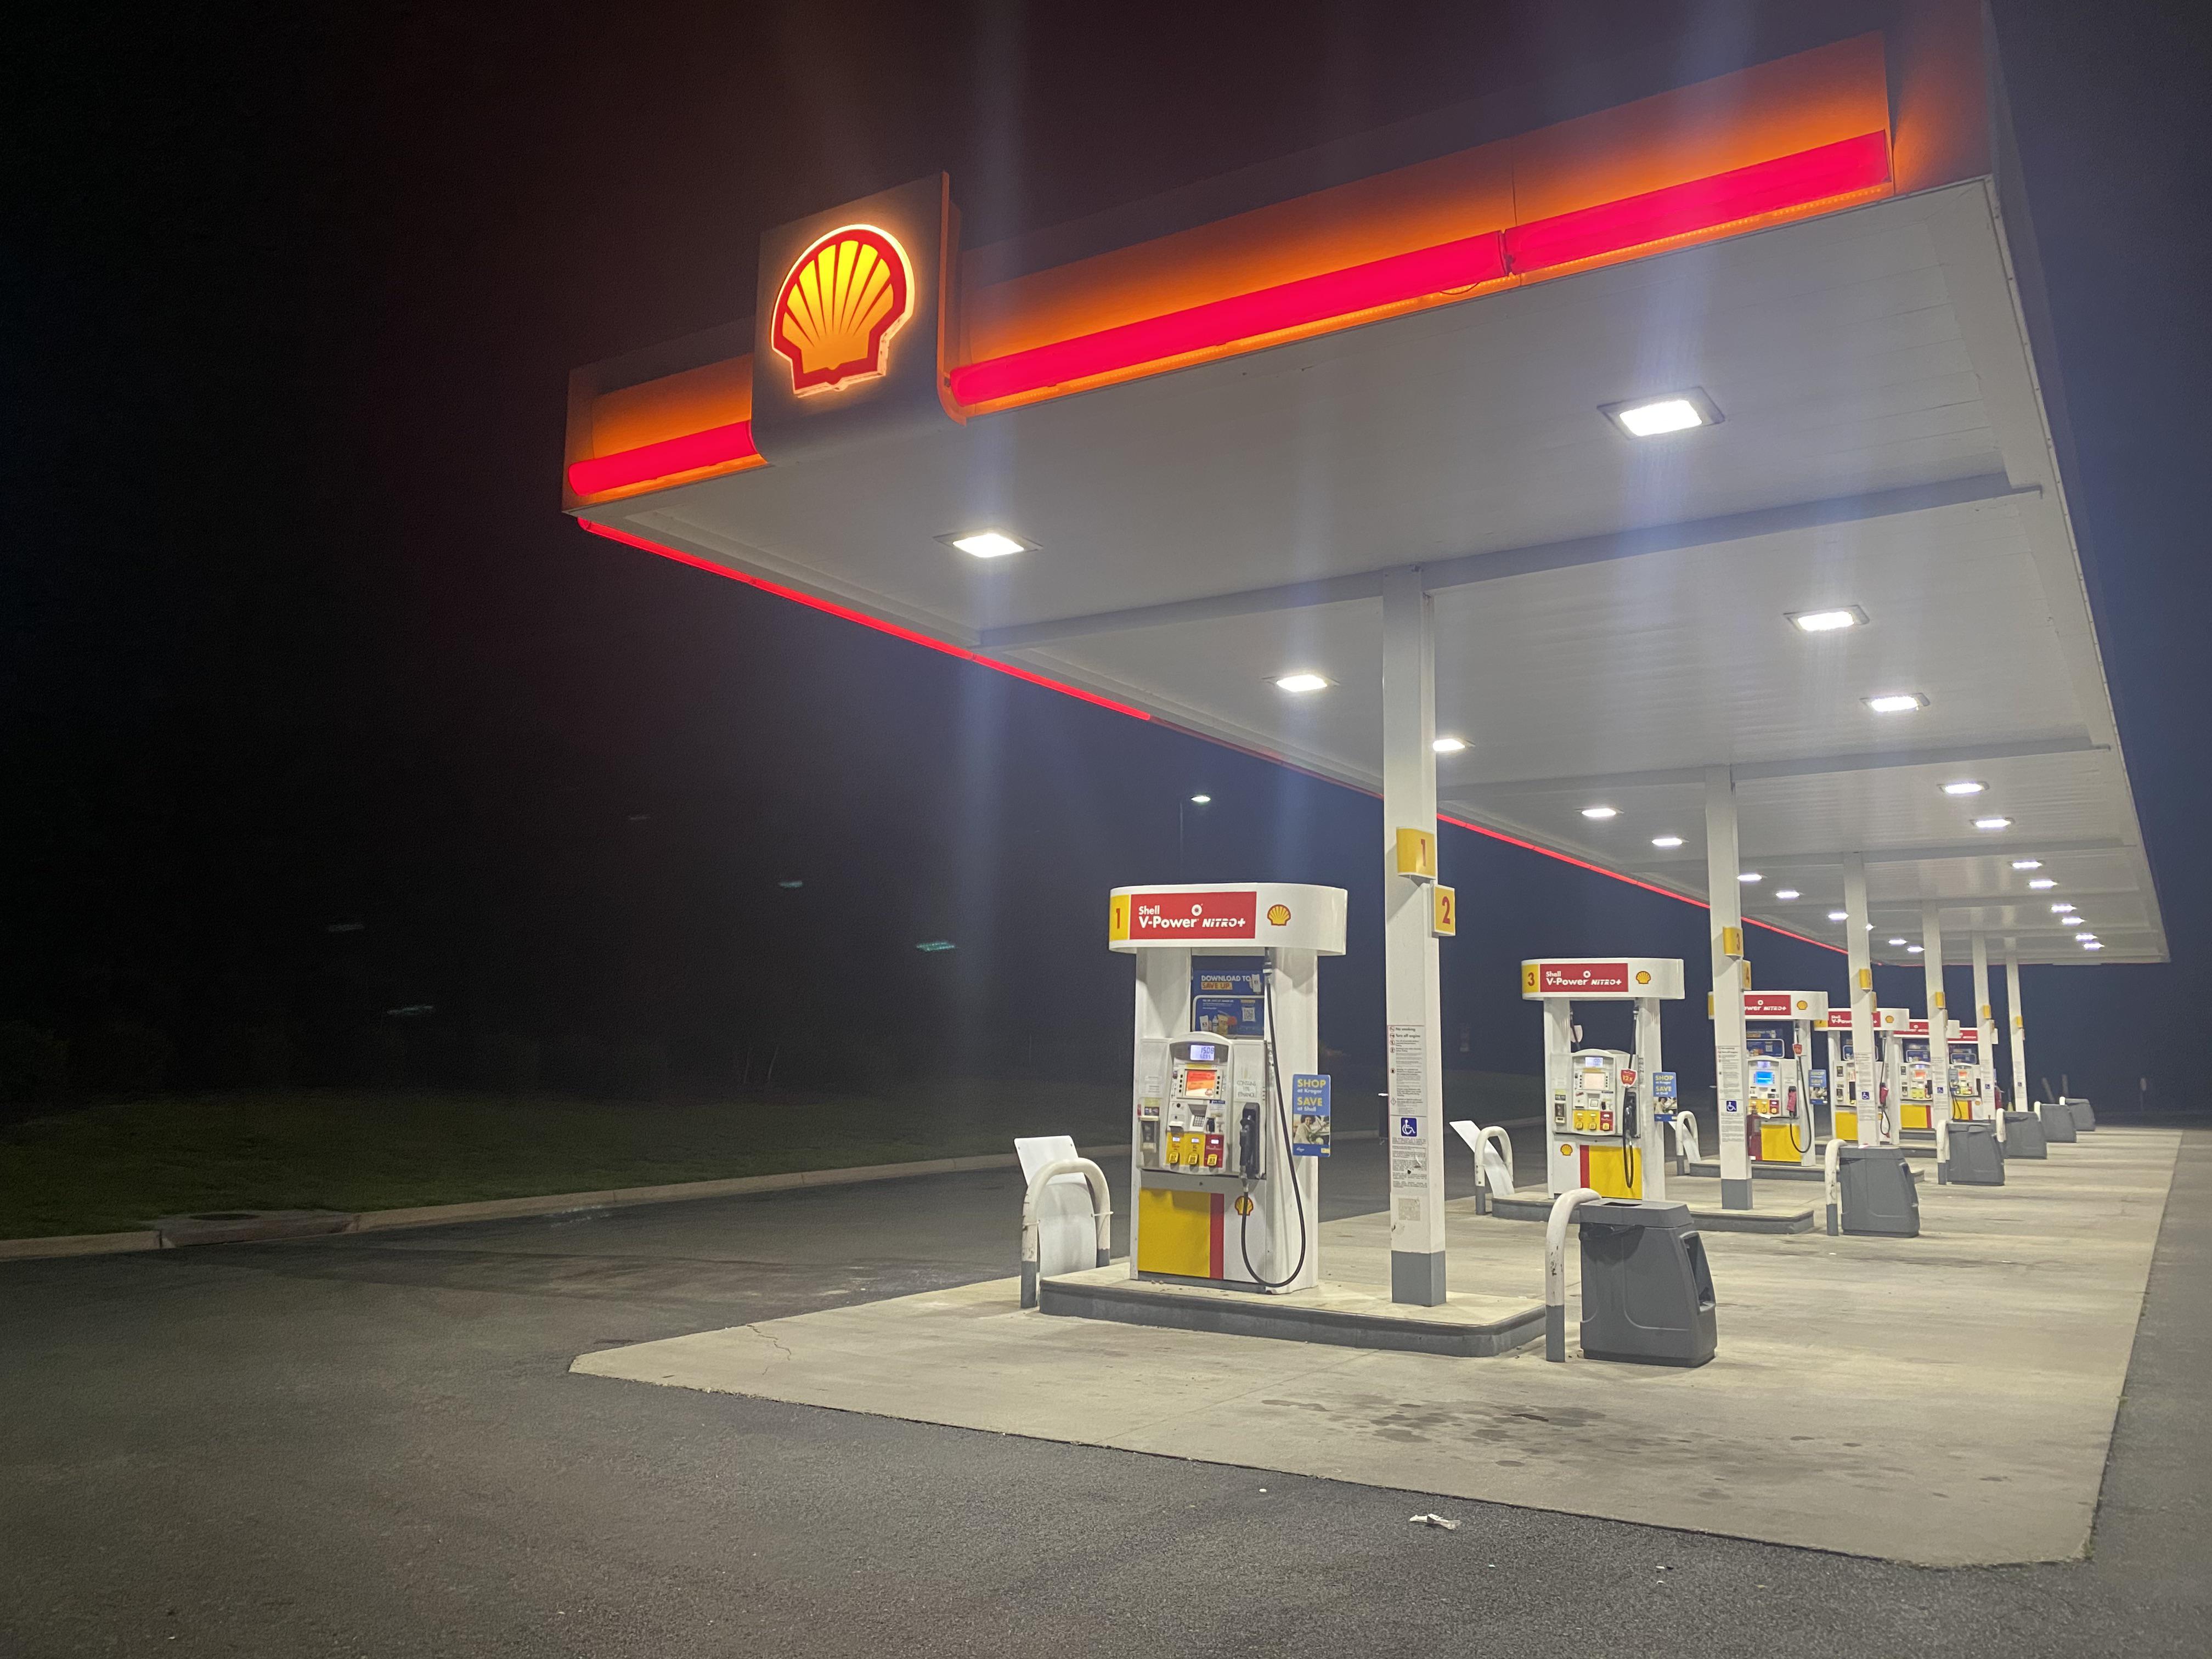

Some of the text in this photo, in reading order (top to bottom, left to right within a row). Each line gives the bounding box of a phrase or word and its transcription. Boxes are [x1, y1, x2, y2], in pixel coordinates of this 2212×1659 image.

[1420, 838, 1426, 867] 1
[1138, 905, 1160, 916] Shell
[1442, 896, 1451, 924] 2
[1116, 908, 1120, 929] 1
[1138, 916, 1198, 929] V-Power
[1736, 933, 1741, 951] 3
[1527, 972, 1535, 986] 3
[1546, 978, 1589, 986] V-Power
[1297, 1079, 1326, 1088] SHOP
[1297, 1097, 1323, 1106] SAVE
